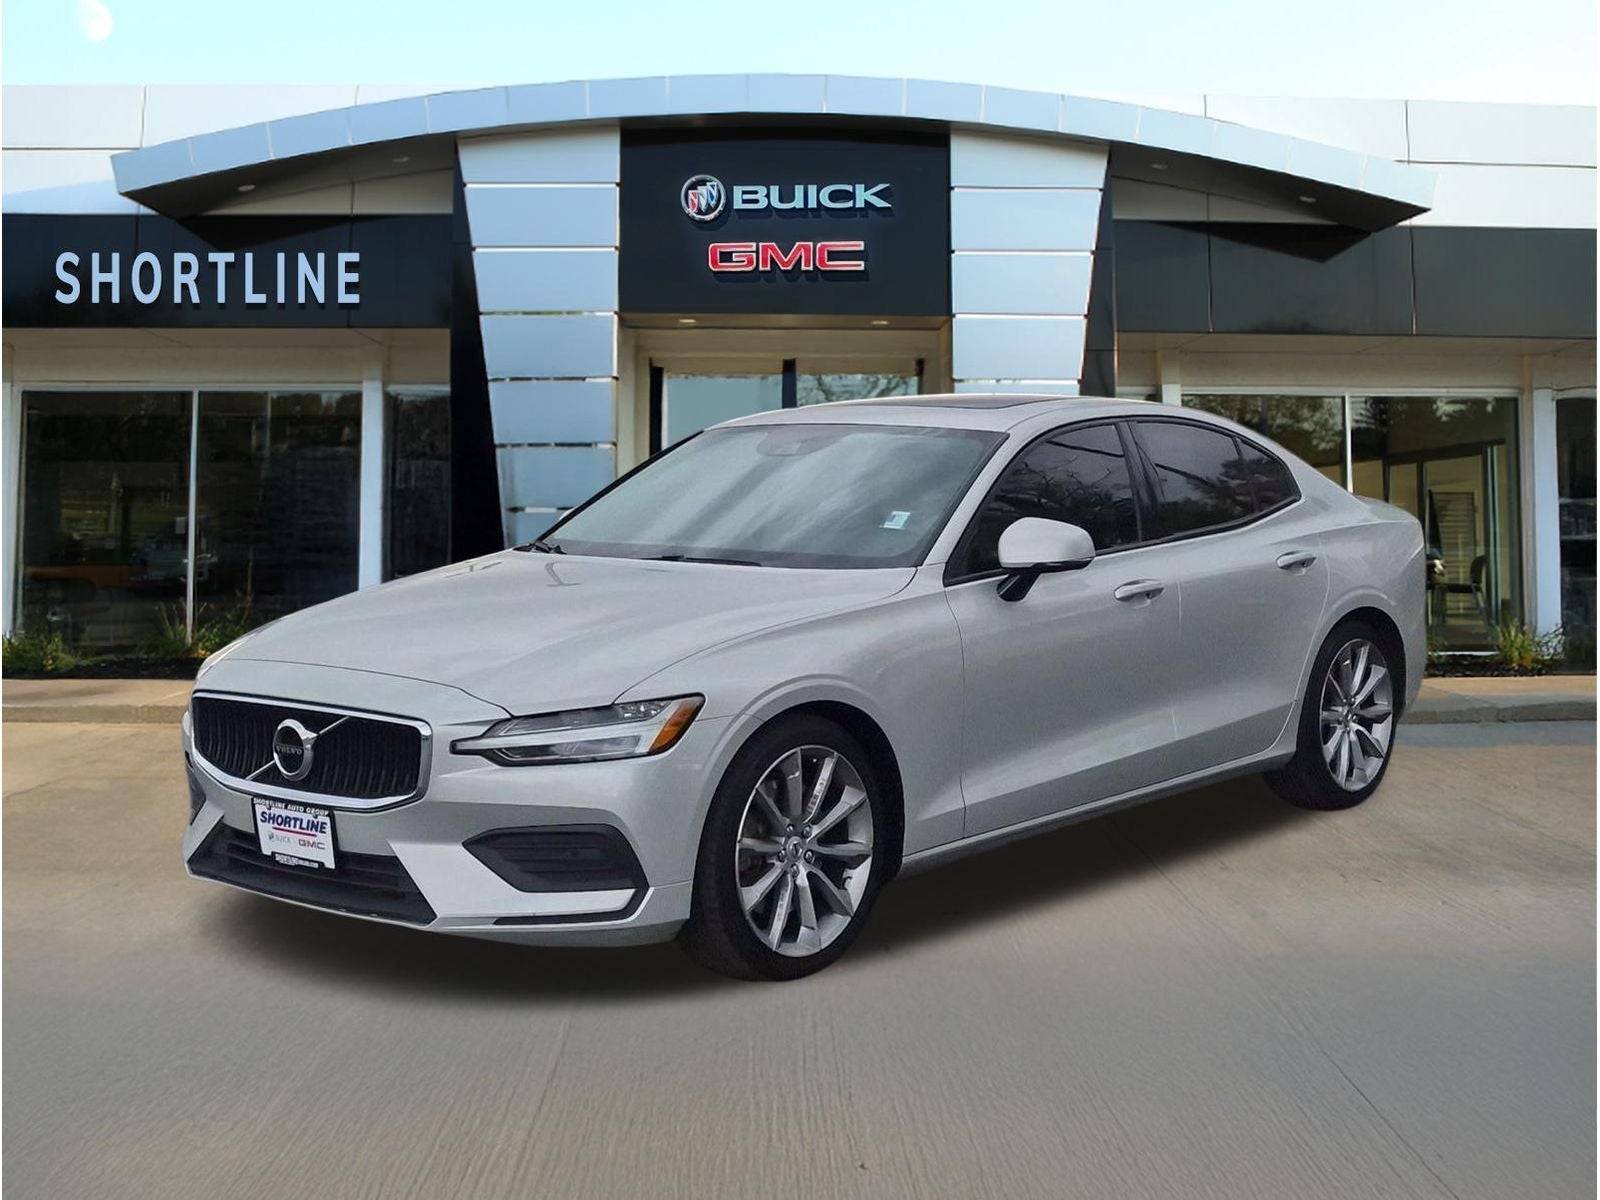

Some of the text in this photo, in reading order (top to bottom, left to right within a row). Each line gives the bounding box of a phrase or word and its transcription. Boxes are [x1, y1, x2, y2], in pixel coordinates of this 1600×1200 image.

[733, 183, 892, 209] BUICK
[708, 241, 865, 271] GMC
[55, 251, 360, 304] SHORTLINE
[275, 745, 303, 755] VOLVO
[253, 797, 329, 816] SHORTLINE AUTO GROUP
[260, 811, 328, 834] SHORTLINE
[298, 839, 326, 850] GMC
